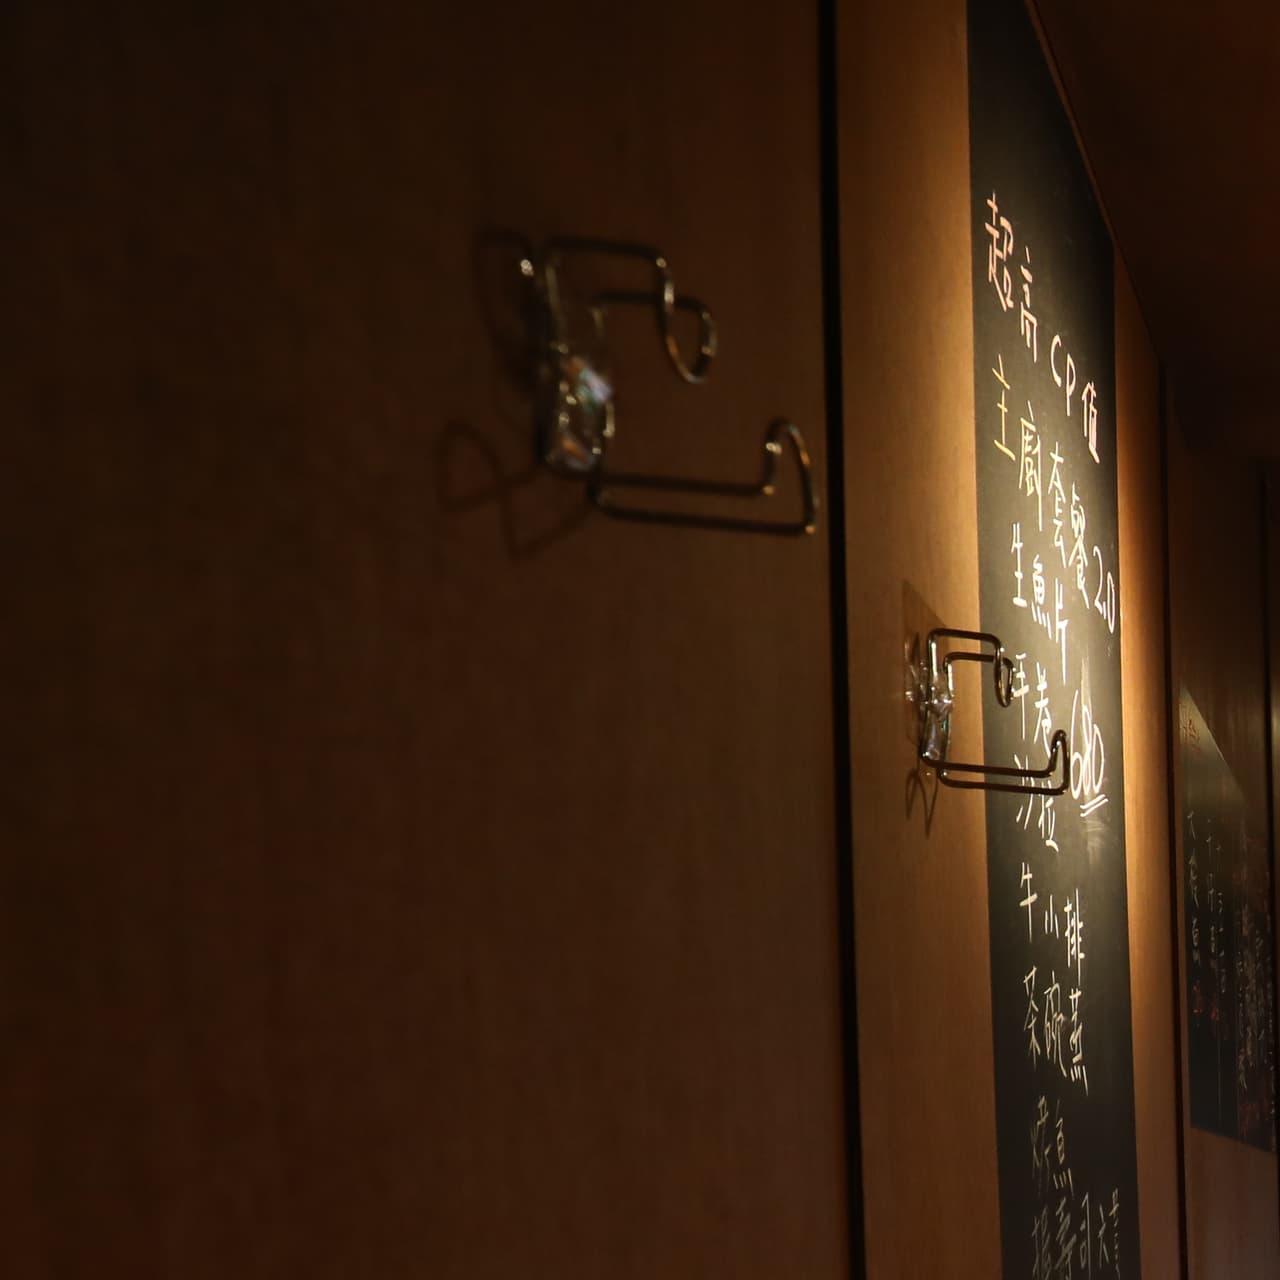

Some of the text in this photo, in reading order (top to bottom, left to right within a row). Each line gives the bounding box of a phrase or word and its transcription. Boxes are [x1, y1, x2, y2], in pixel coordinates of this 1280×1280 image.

[1010, 521, 1069, 687] 生魚片
[1070, 689, 1105, 802] 680
[1019, 861, 1086, 987] 牛小排
[1022, 964, 1089, 1097] 茶碗蒸
